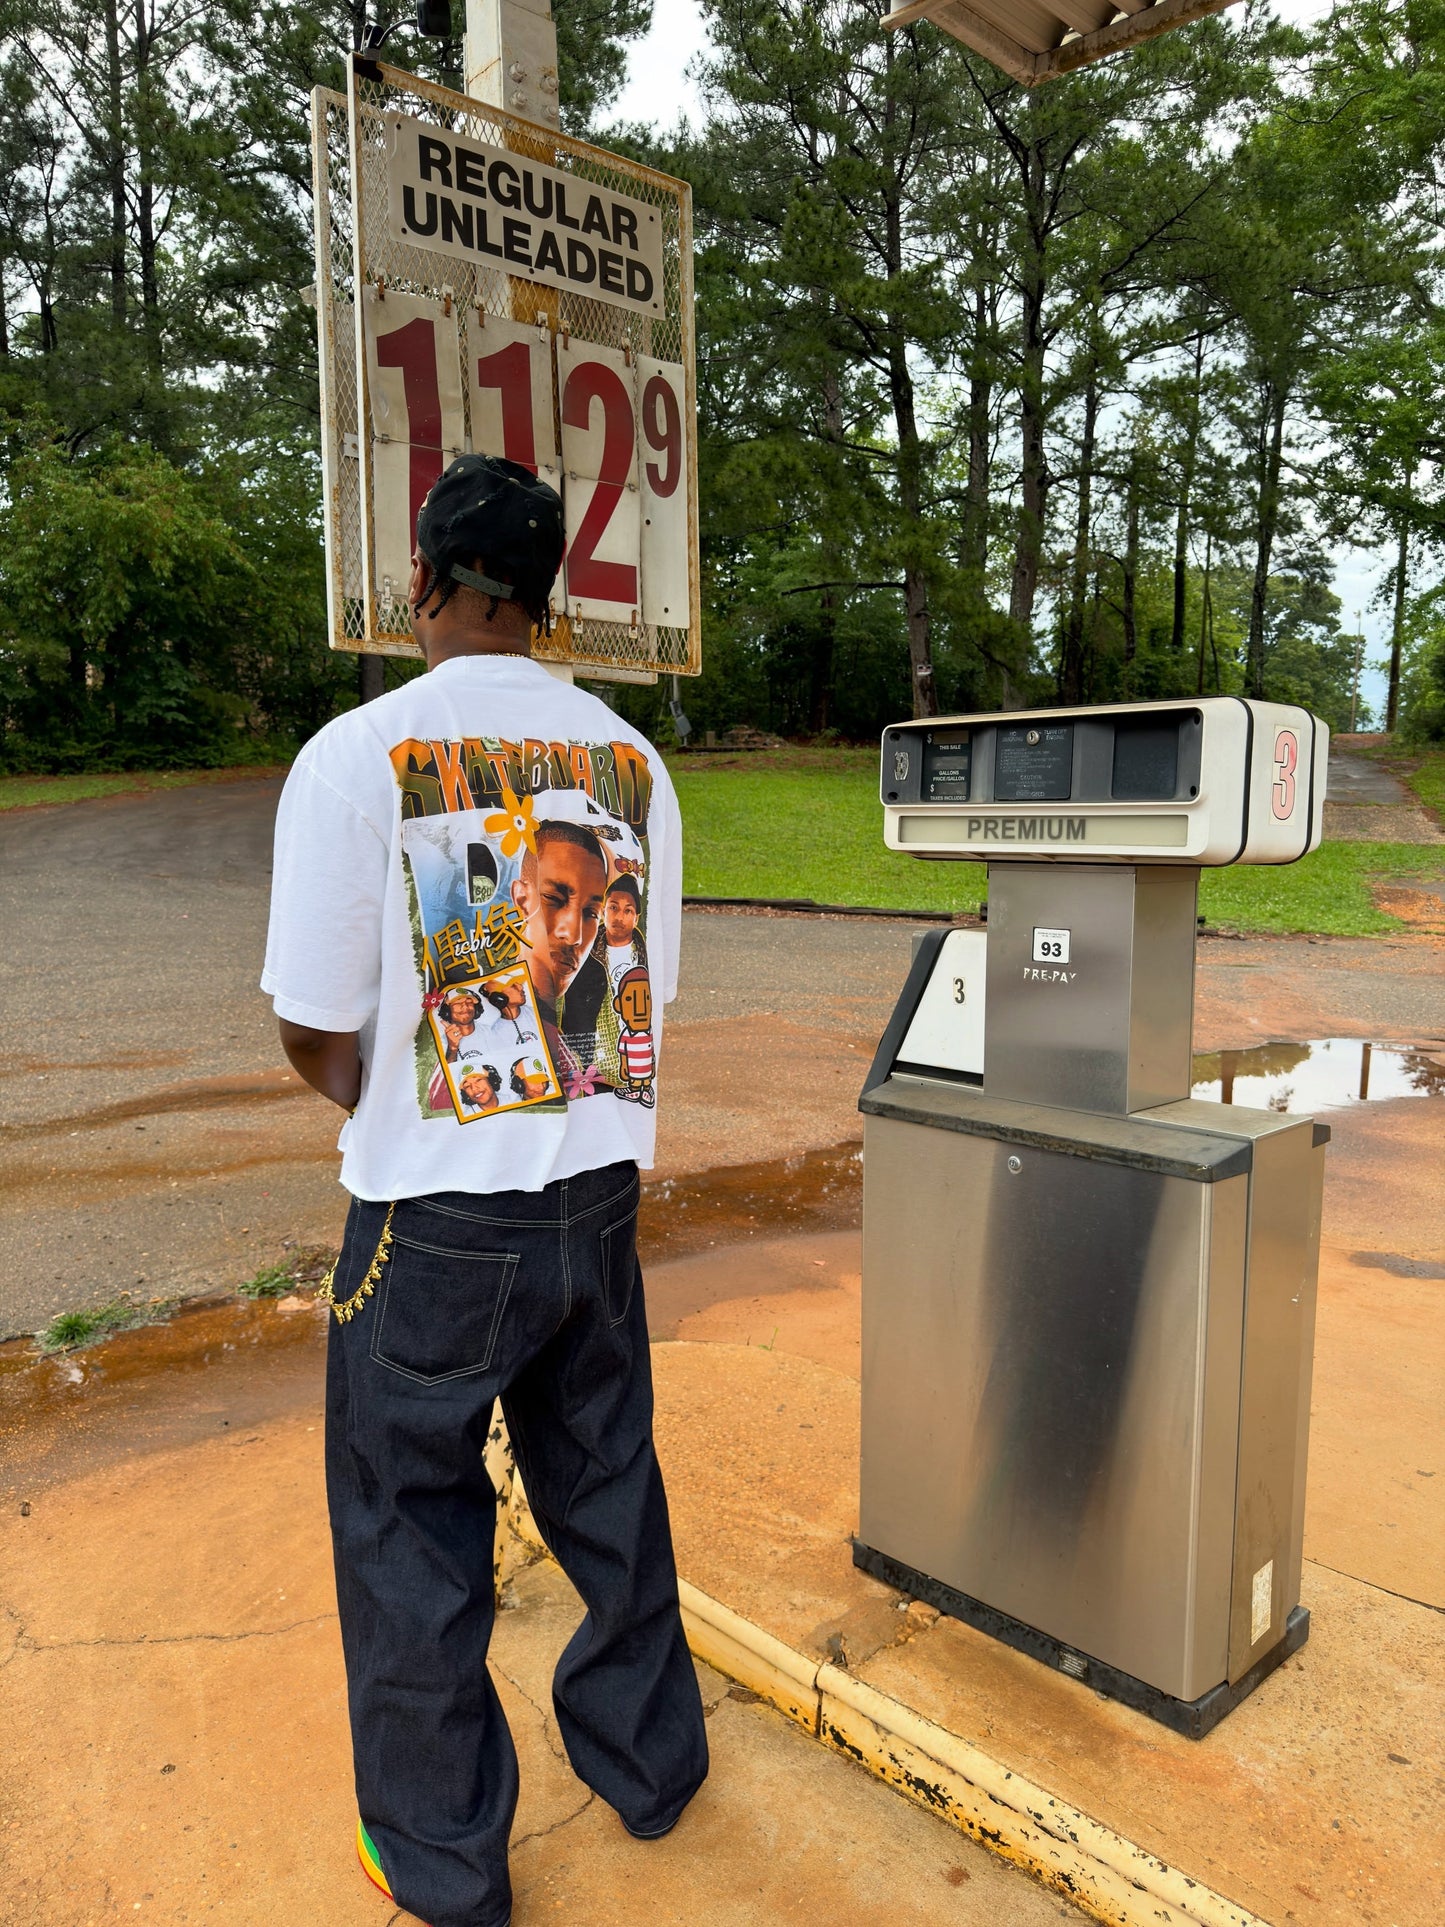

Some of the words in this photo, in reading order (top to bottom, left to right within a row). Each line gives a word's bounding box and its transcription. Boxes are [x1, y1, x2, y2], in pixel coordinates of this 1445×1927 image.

[418, 134, 639, 251] REGULAR
[403, 185, 654, 302] UNLEADED
[388, 737, 653, 838] SKATEBOARD
[930, 783, 935, 793] $
[1271, 730, 1298, 820] 3
[967, 818, 1087, 840] PREMIUM
[1041, 941, 1062, 957] 93
[1023, 967, 1077, 983] PRE-PAY
[954, 978, 965, 1004] 3
